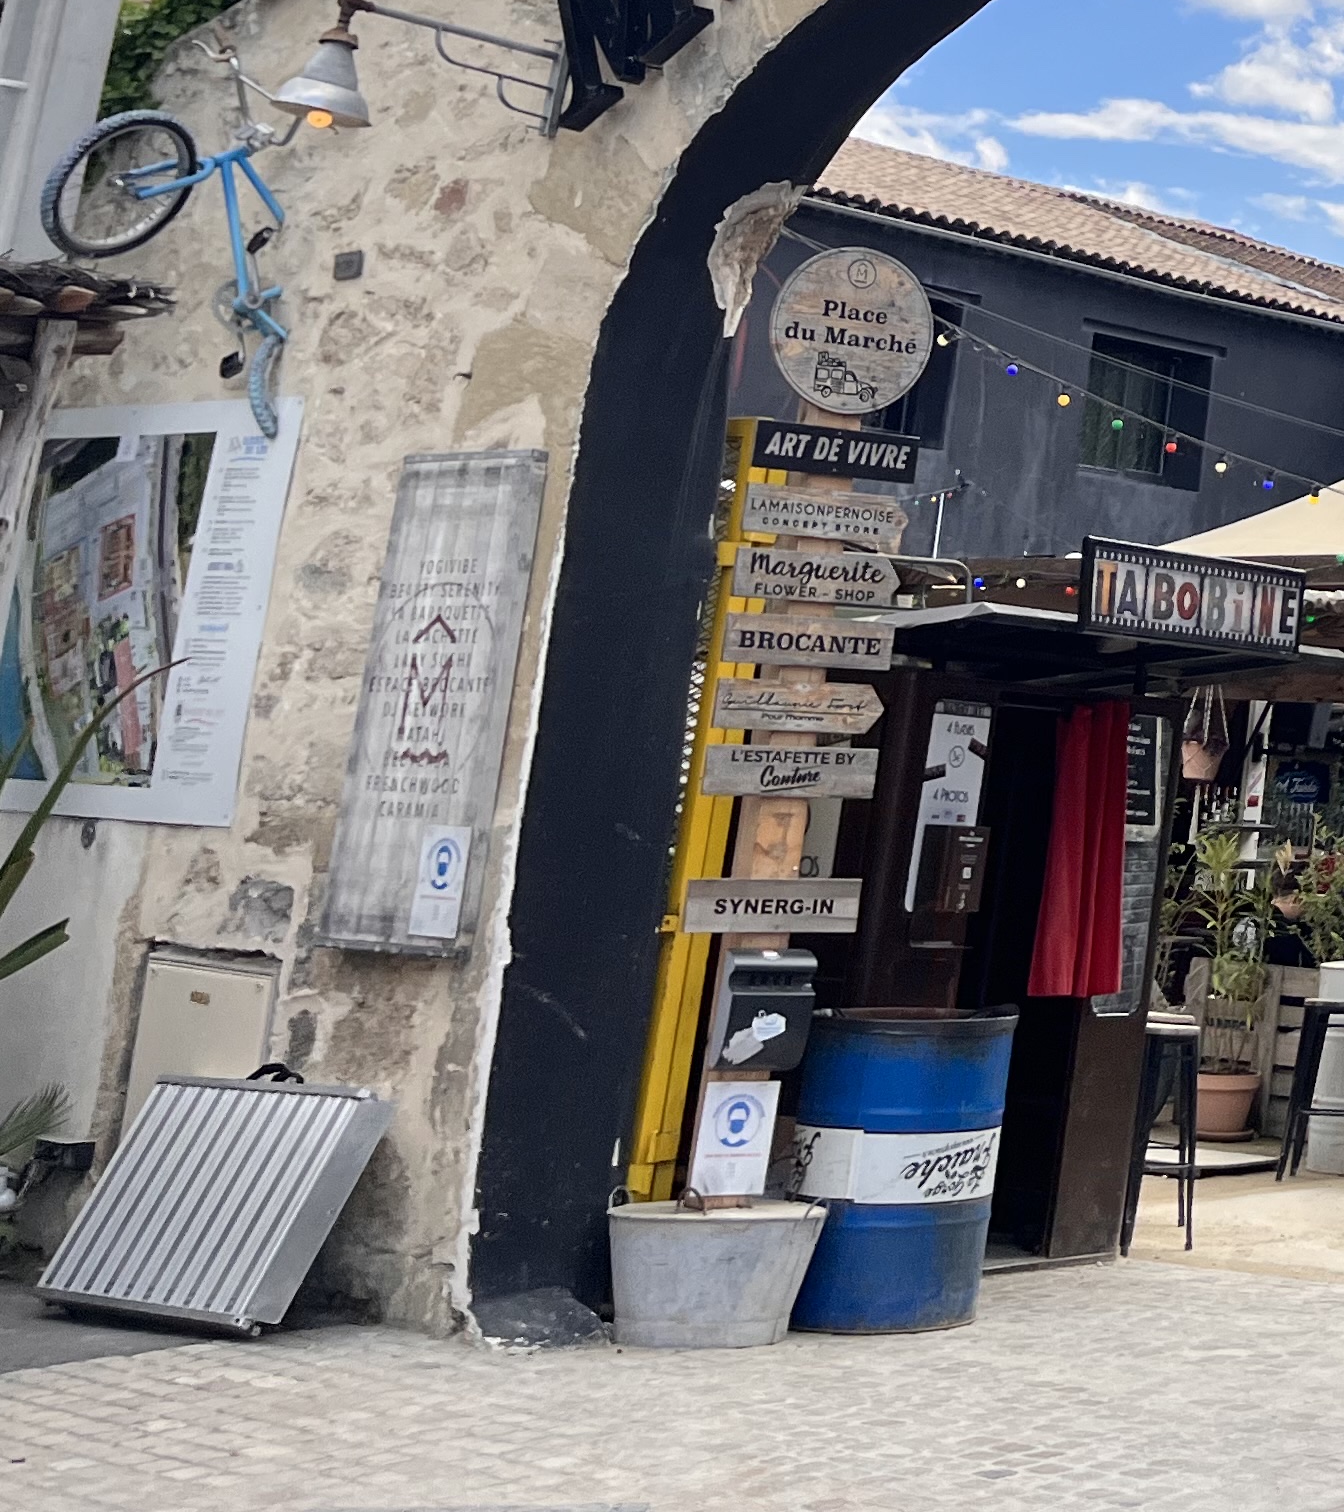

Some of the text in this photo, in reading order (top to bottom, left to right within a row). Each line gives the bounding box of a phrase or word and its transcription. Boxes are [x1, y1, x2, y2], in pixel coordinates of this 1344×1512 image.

[822, 299, 888, 324] Place
[784, 321, 917, 355] du Marché
[764, 431, 911, 470] ART DE VIVRE
[751, 498, 894, 524] LAMAISONPERNOISE
[762, 517, 880, 535] CONCEPT STORE
[750, 552, 886, 585] Marguerite
[754, 583, 818, 598] FLOWER
[835, 588, 876, 602] SHOP
[738, 630, 882, 657] BROCANTE
[731, 750, 858, 766] L'ESTAFETTE BY
[760, 764, 822, 788] Couture
[714, 898, 836, 915] SYNERG-IN
